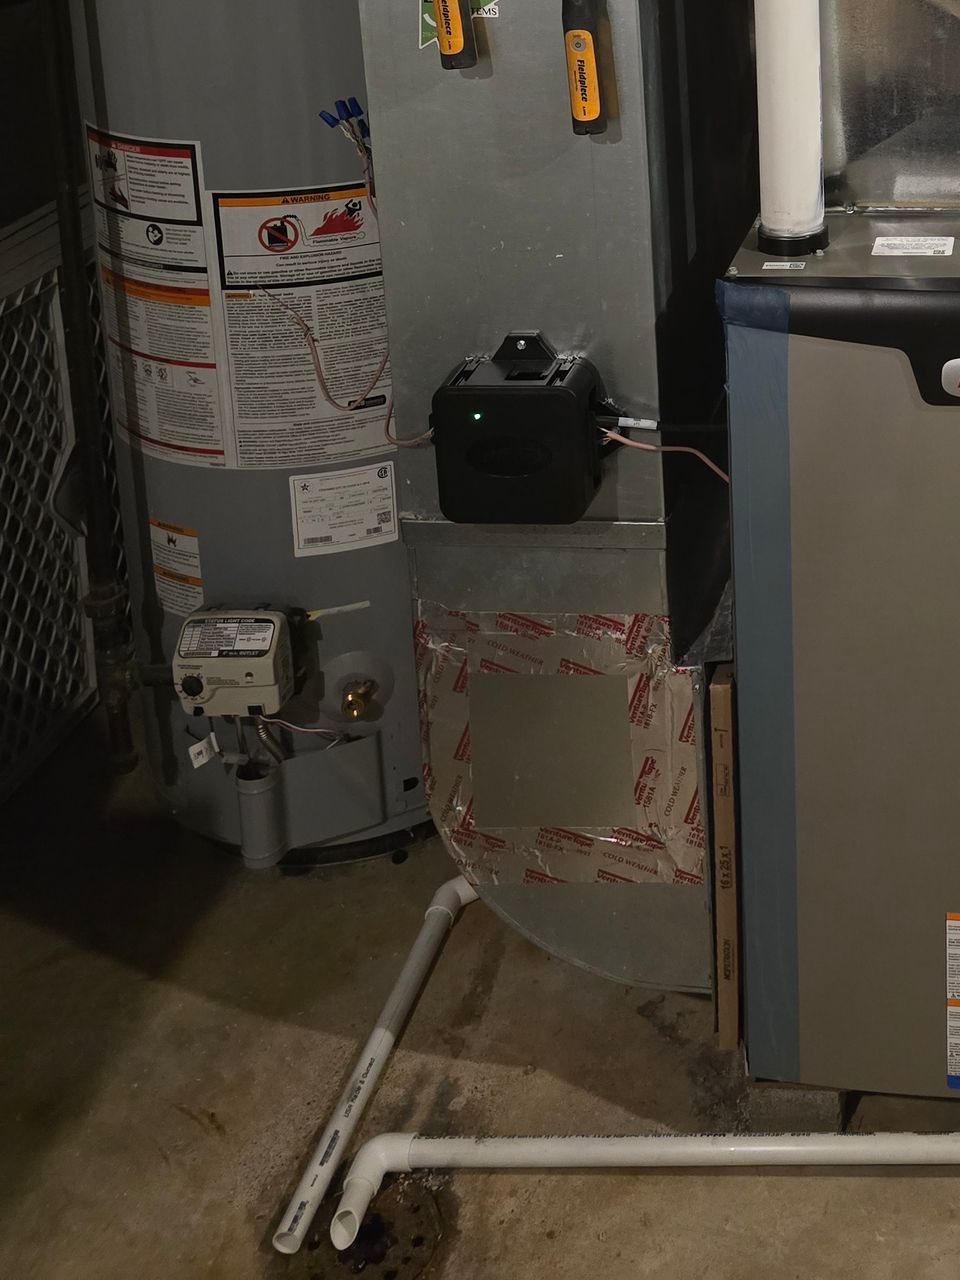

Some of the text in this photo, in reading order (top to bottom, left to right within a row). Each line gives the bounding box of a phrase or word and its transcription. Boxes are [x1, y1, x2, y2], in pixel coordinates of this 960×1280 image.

[576, 58, 589, 104] Fieldpiece
[290, 193, 331, 203] WARNING
[487, 639, 509, 652] COLD
[663, 796, 675, 817] COLD
[603, 851, 659, 876] COLD WEATHER
[719, 860, 730, 871] 25
[719, 880, 730, 890] 16
[343, 1104, 353, 1118] USA
